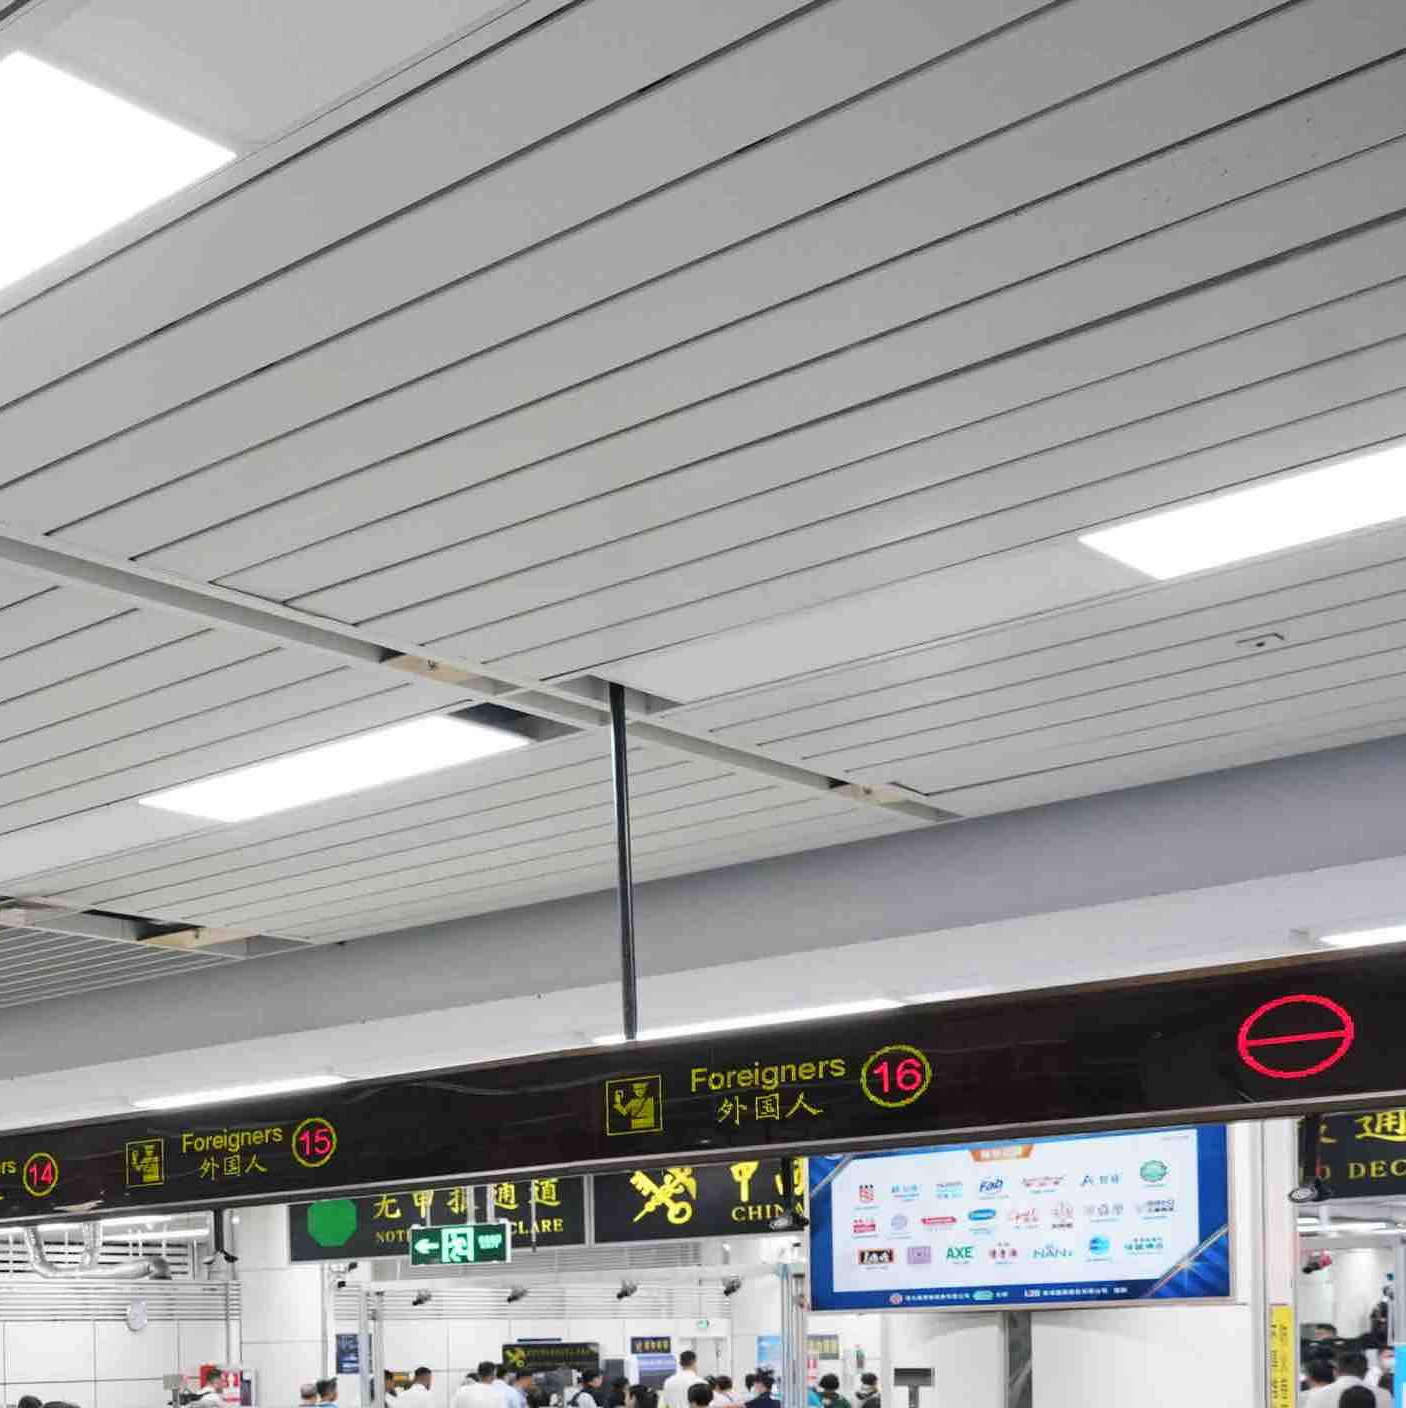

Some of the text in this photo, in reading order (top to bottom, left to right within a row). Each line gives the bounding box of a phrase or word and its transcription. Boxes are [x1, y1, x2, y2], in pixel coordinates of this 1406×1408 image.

[690, 1056, 846, 1092] Foreigners
[873, 1058, 923, 1092] 16
[717, 1092, 823, 1125] 外国人
[181, 1123, 283, 1153] Foreigners
[299, 1129, 330, 1155] 15
[29, 1163, 53, 1186] 14
[199, 1153, 267, 1178] 外国人
[1347, 1159, 1406, 1179] DEC
[510, 1218, 564, 1235] CLARE
[946, 1246, 972, 1260] AXE
